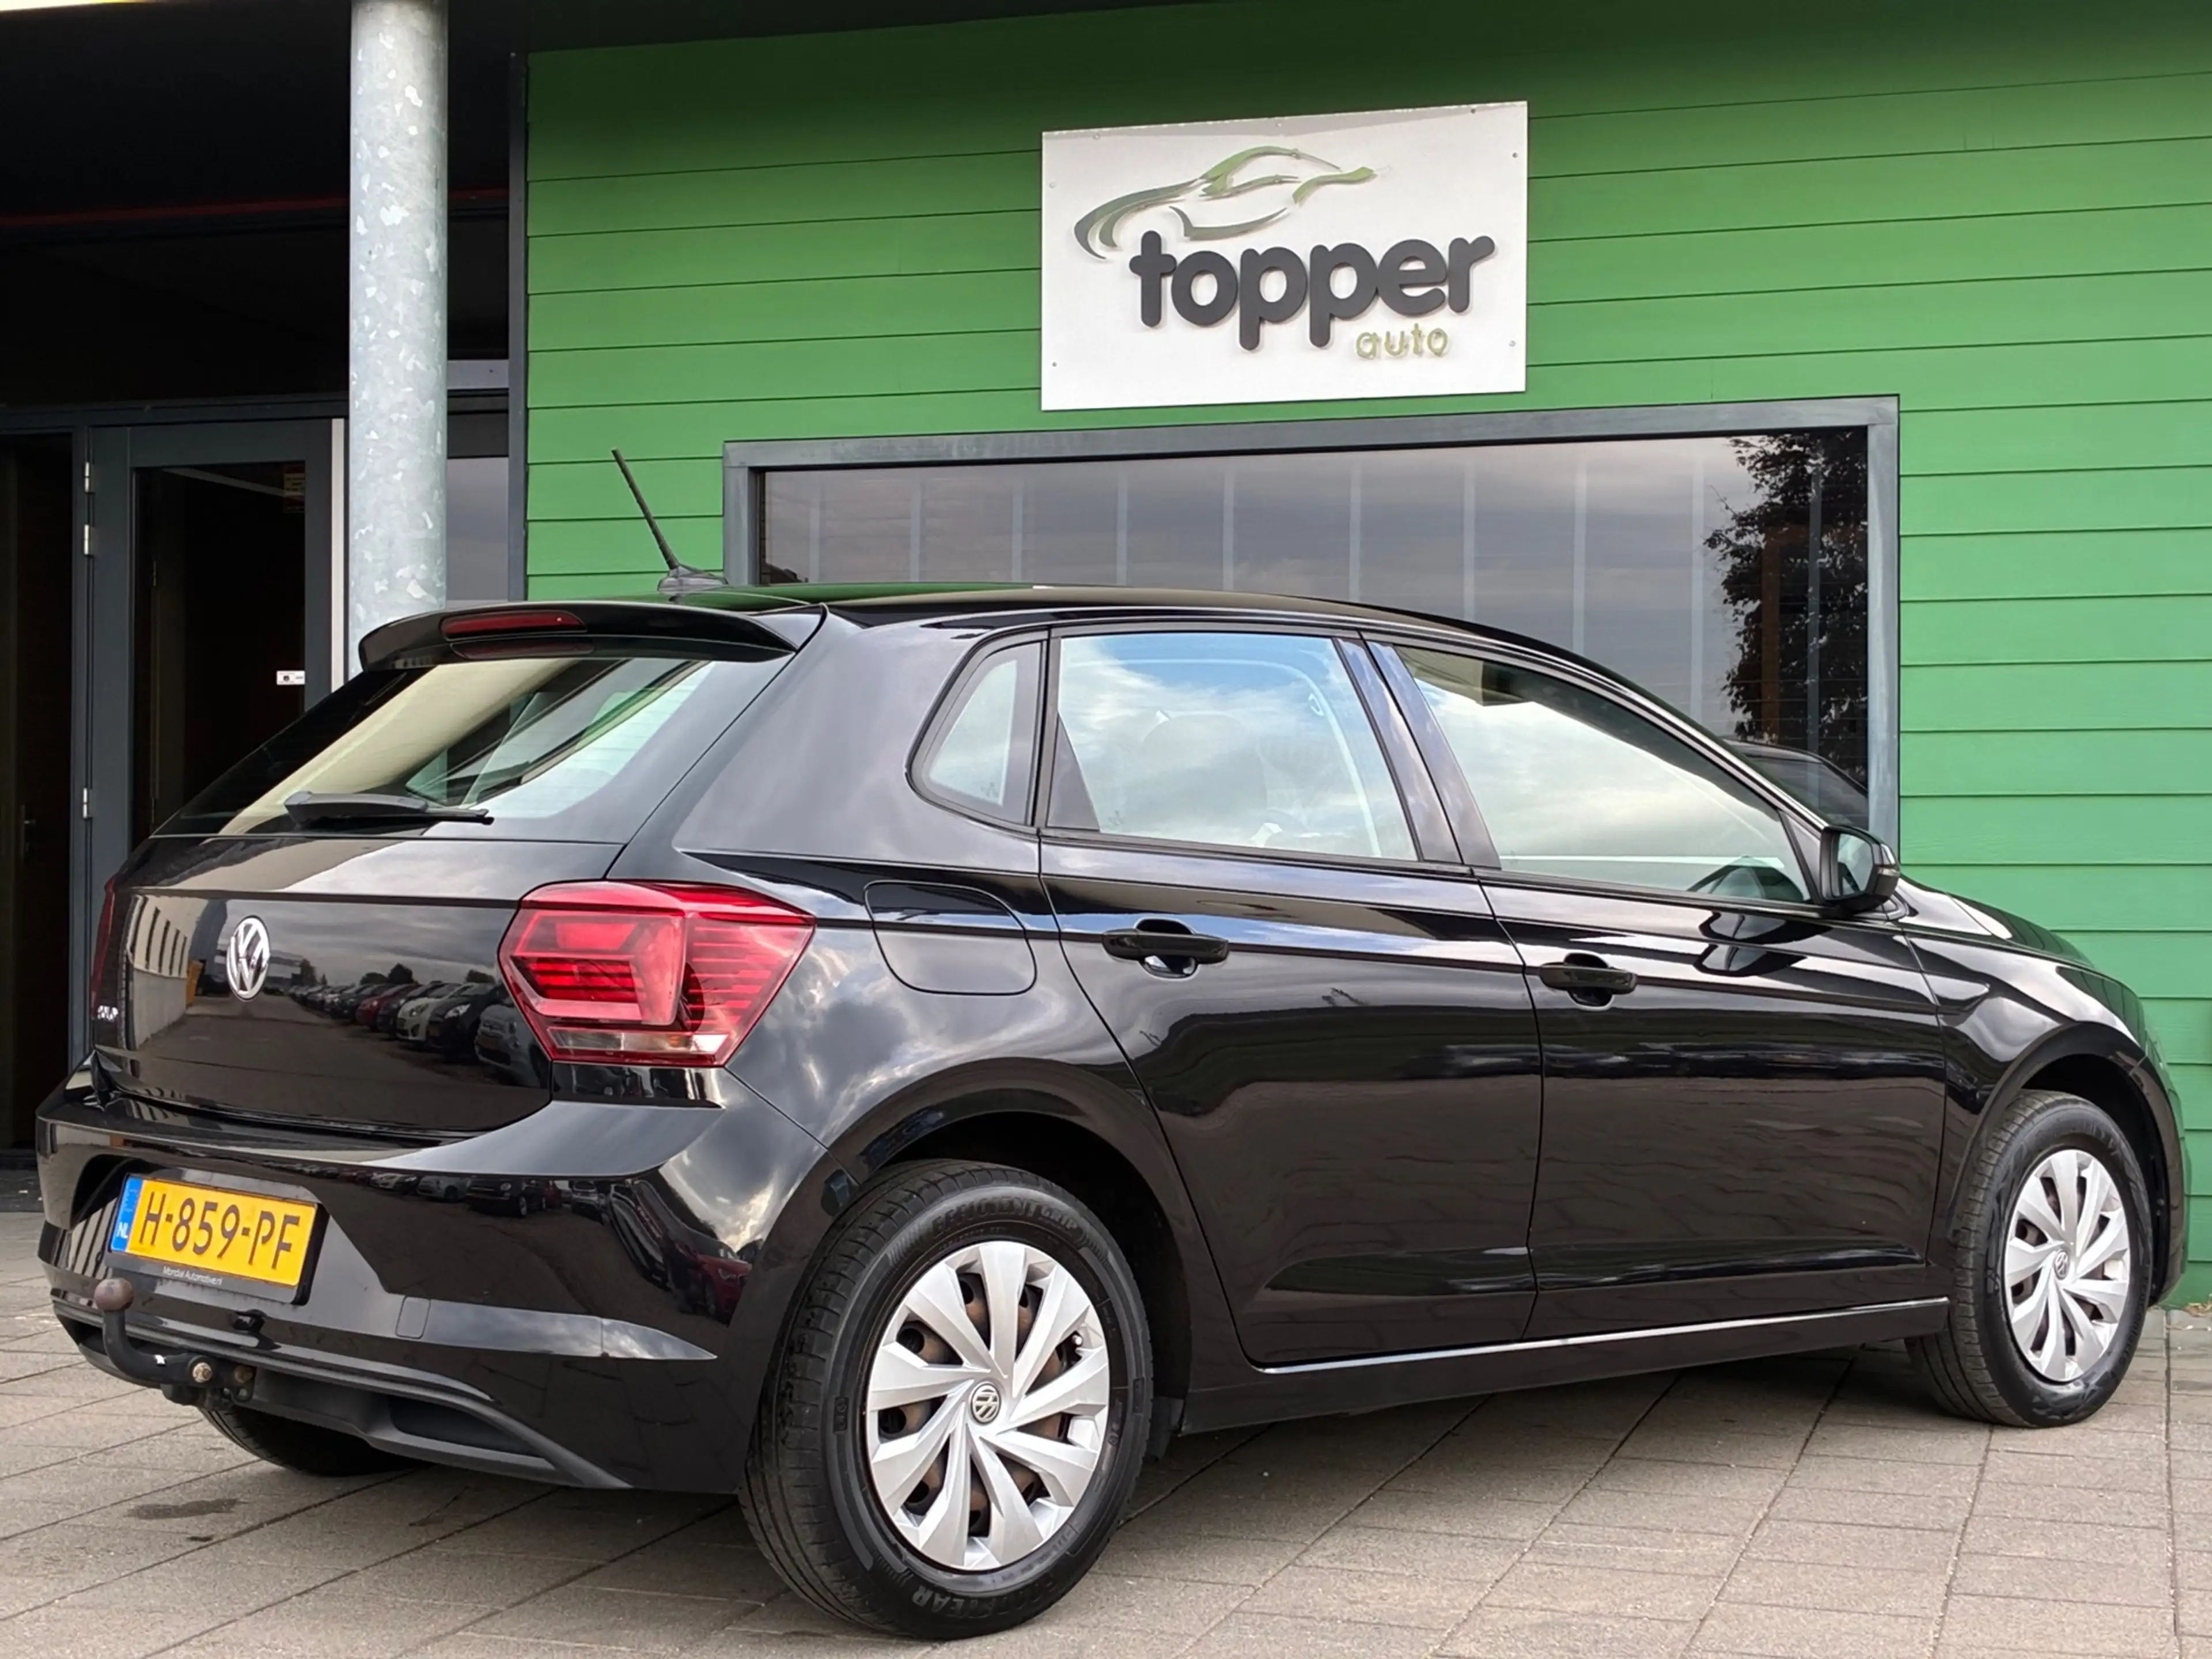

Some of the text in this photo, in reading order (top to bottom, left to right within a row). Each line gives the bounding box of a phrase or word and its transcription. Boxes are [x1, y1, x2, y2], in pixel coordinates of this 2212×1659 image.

[1129, 230, 1495, 351] topper
[1356, 323, 1448, 359] auto
[116, 1222, 128, 1238] NL
[139, 1191, 301, 1269] H-859-PF
